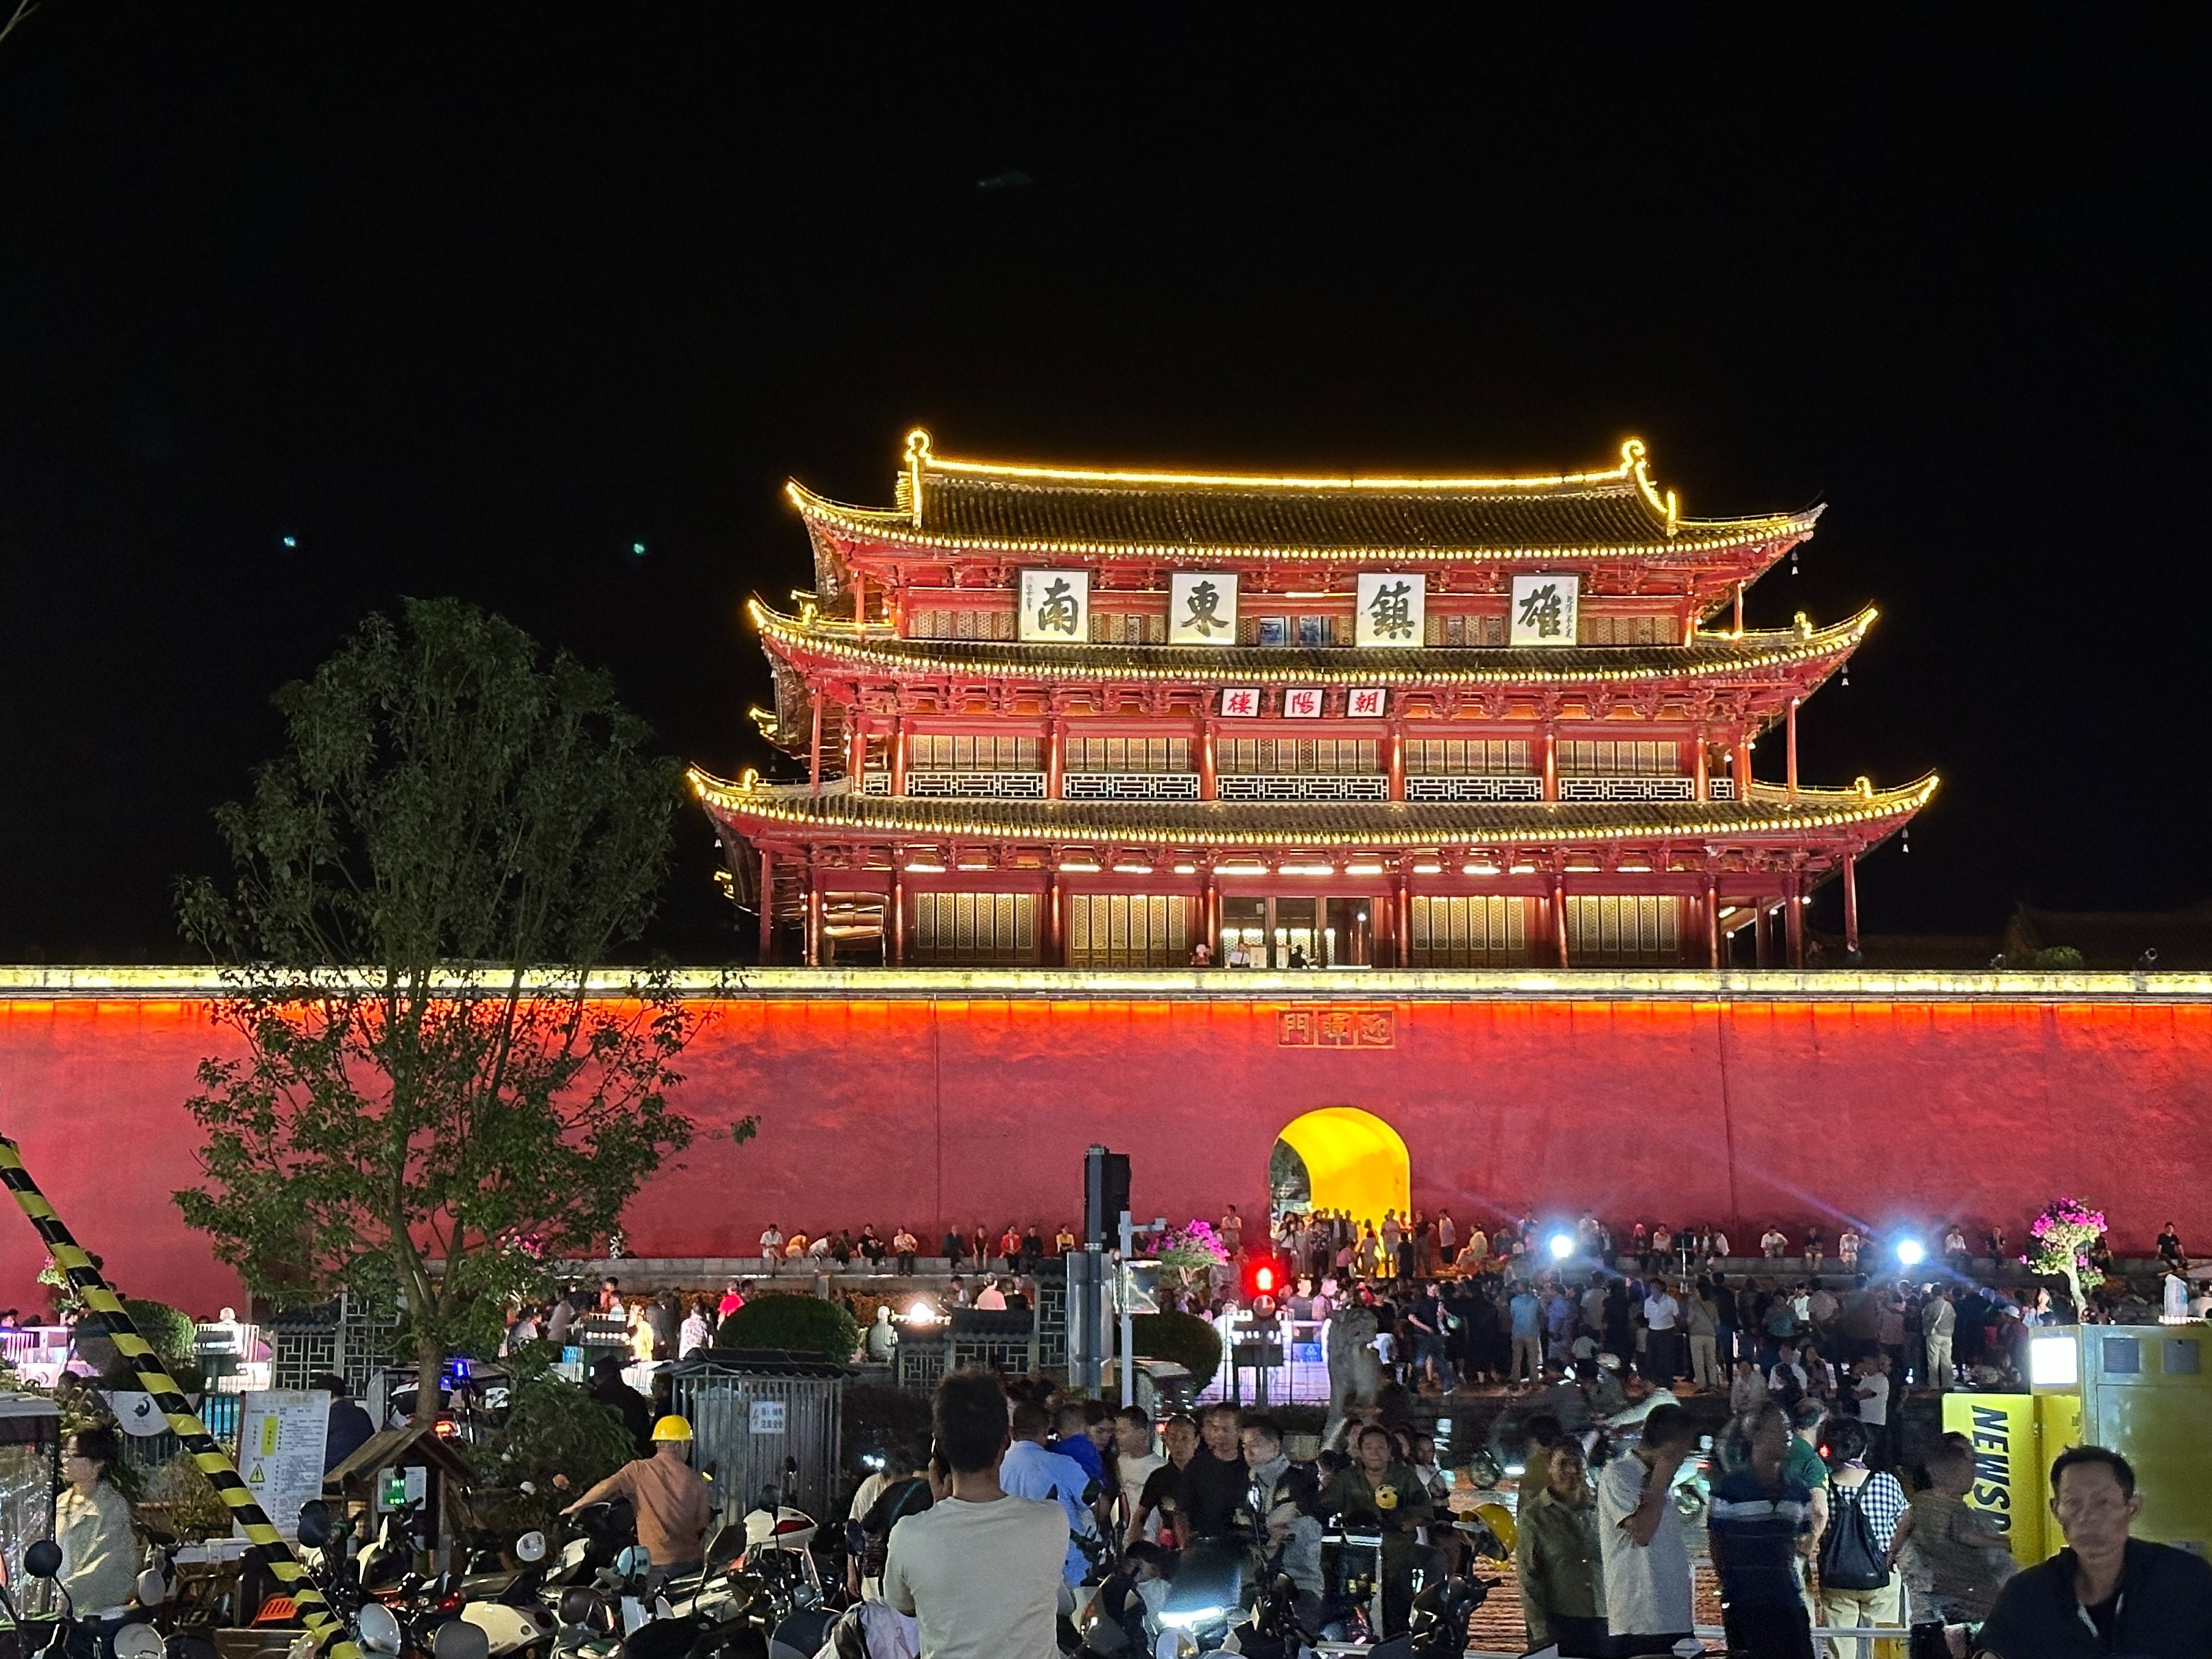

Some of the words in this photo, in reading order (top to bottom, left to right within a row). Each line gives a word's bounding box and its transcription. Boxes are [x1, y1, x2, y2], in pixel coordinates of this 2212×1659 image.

[1038, 577, 1079, 636] 南
[1180, 582, 1230, 638] 東
[1366, 580, 1416, 639] 鎮
[1518, 583, 1562, 638] 雄
[1971, 1405, 2012, 1549] NEWSP
